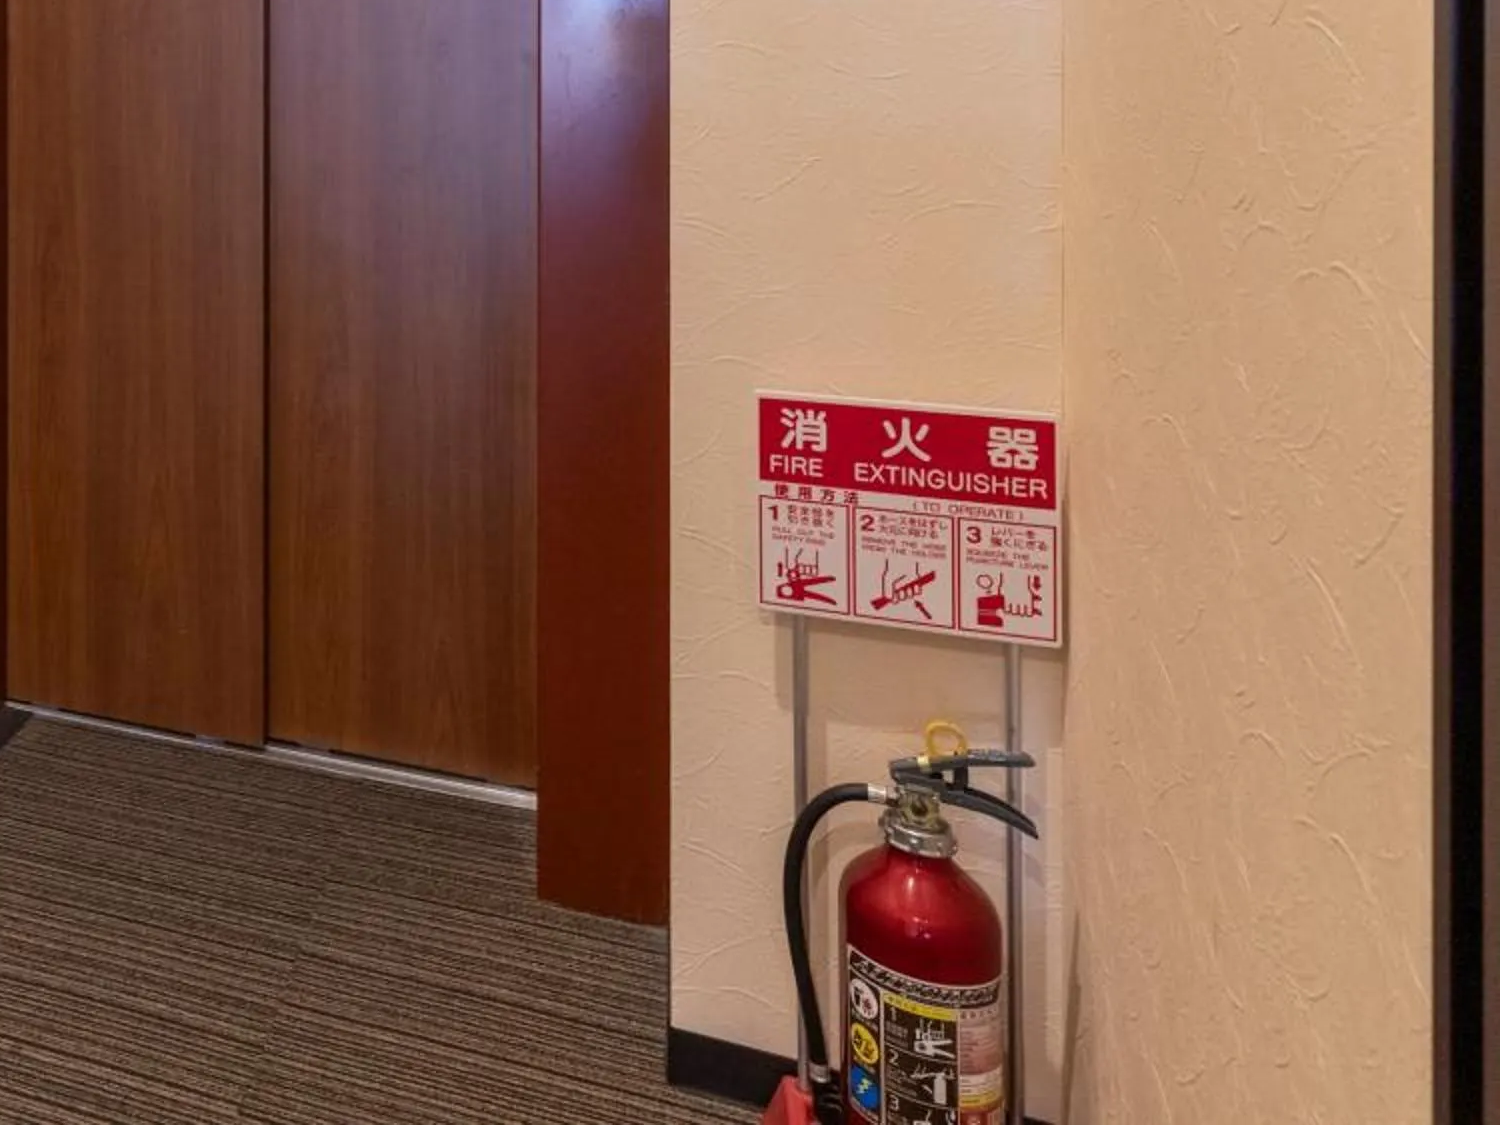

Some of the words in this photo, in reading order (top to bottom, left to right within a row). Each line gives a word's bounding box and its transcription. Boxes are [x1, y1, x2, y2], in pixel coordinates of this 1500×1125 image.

[780, 407, 1039, 472] 消火器
[769, 454, 824, 478] FIRE
[853, 462, 1049, 500] EXTINGUISHER
[775, 483, 859, 505] 使用方法
[768, 505, 778, 521] 1
[860, 514, 875, 531] 2
[966, 526, 982, 544] 3
[889, 1048, 899, 1066] 2
